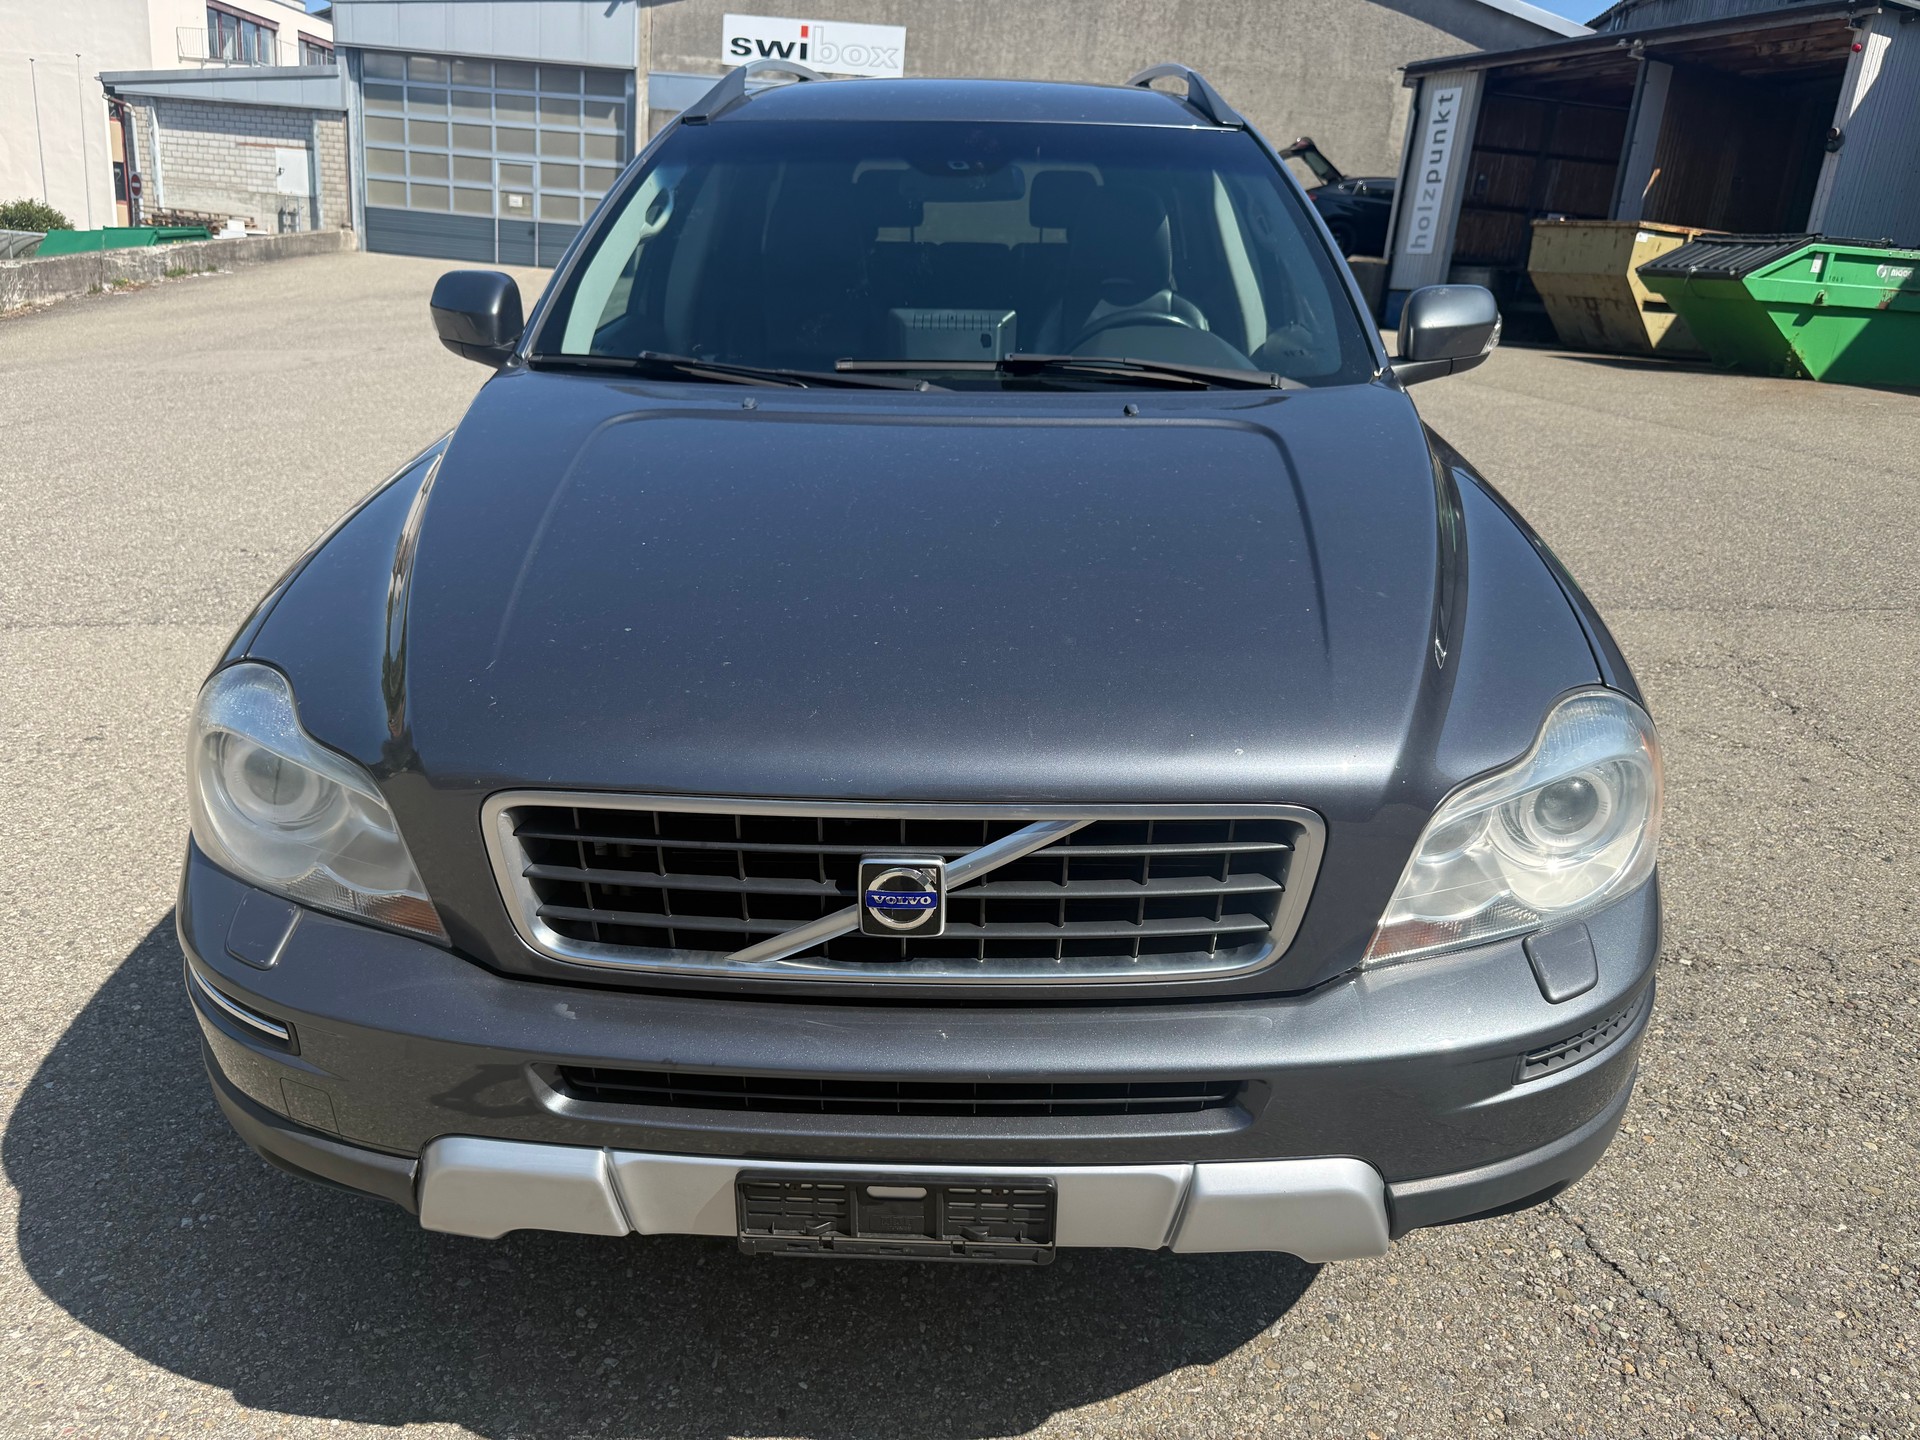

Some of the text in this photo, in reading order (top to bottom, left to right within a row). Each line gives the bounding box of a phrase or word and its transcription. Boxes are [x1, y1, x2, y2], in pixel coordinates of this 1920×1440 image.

[730, 25, 898, 68] swibox
[1410, 93, 1454, 249] holzpunkt
[871, 895, 932, 905] VOLVO
